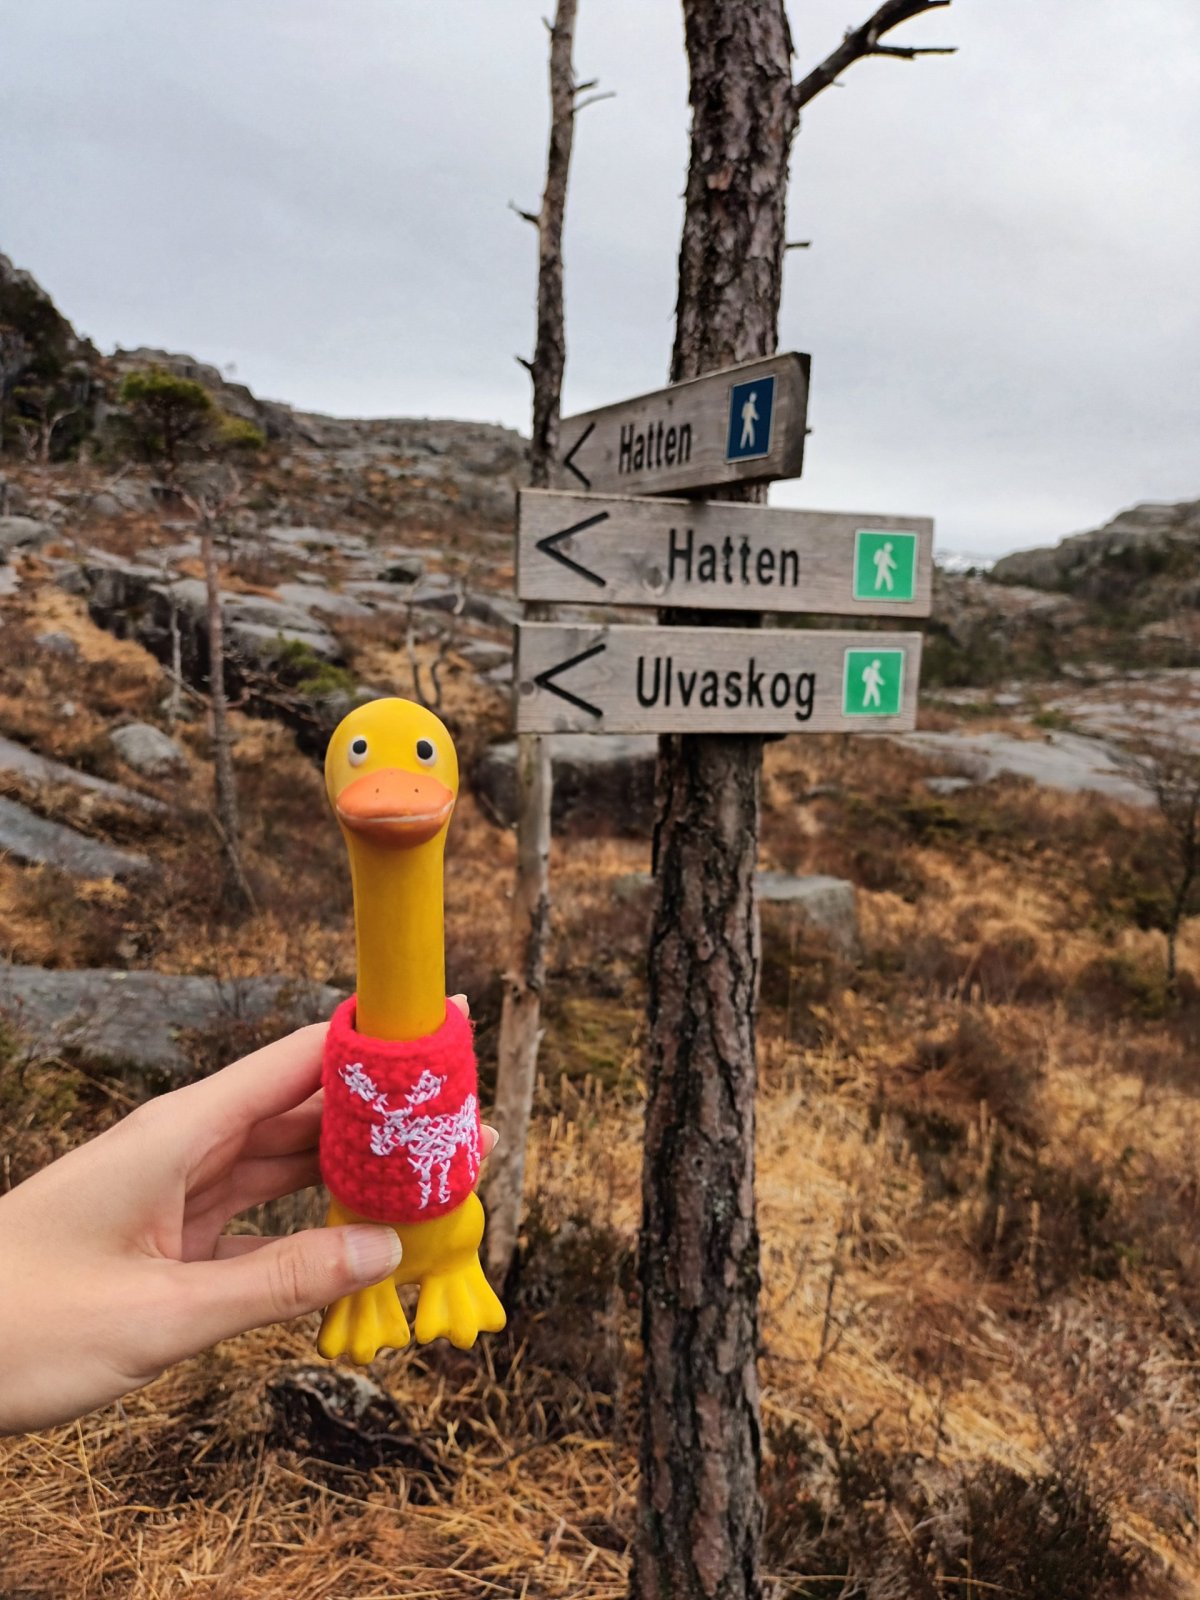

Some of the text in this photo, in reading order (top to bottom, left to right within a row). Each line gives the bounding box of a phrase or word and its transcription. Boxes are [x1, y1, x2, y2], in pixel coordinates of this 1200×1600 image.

[619, 421, 692, 474] Hatten
[668, 528, 799, 587] Hatten
[636, 655, 816, 721] Ulvaskog
